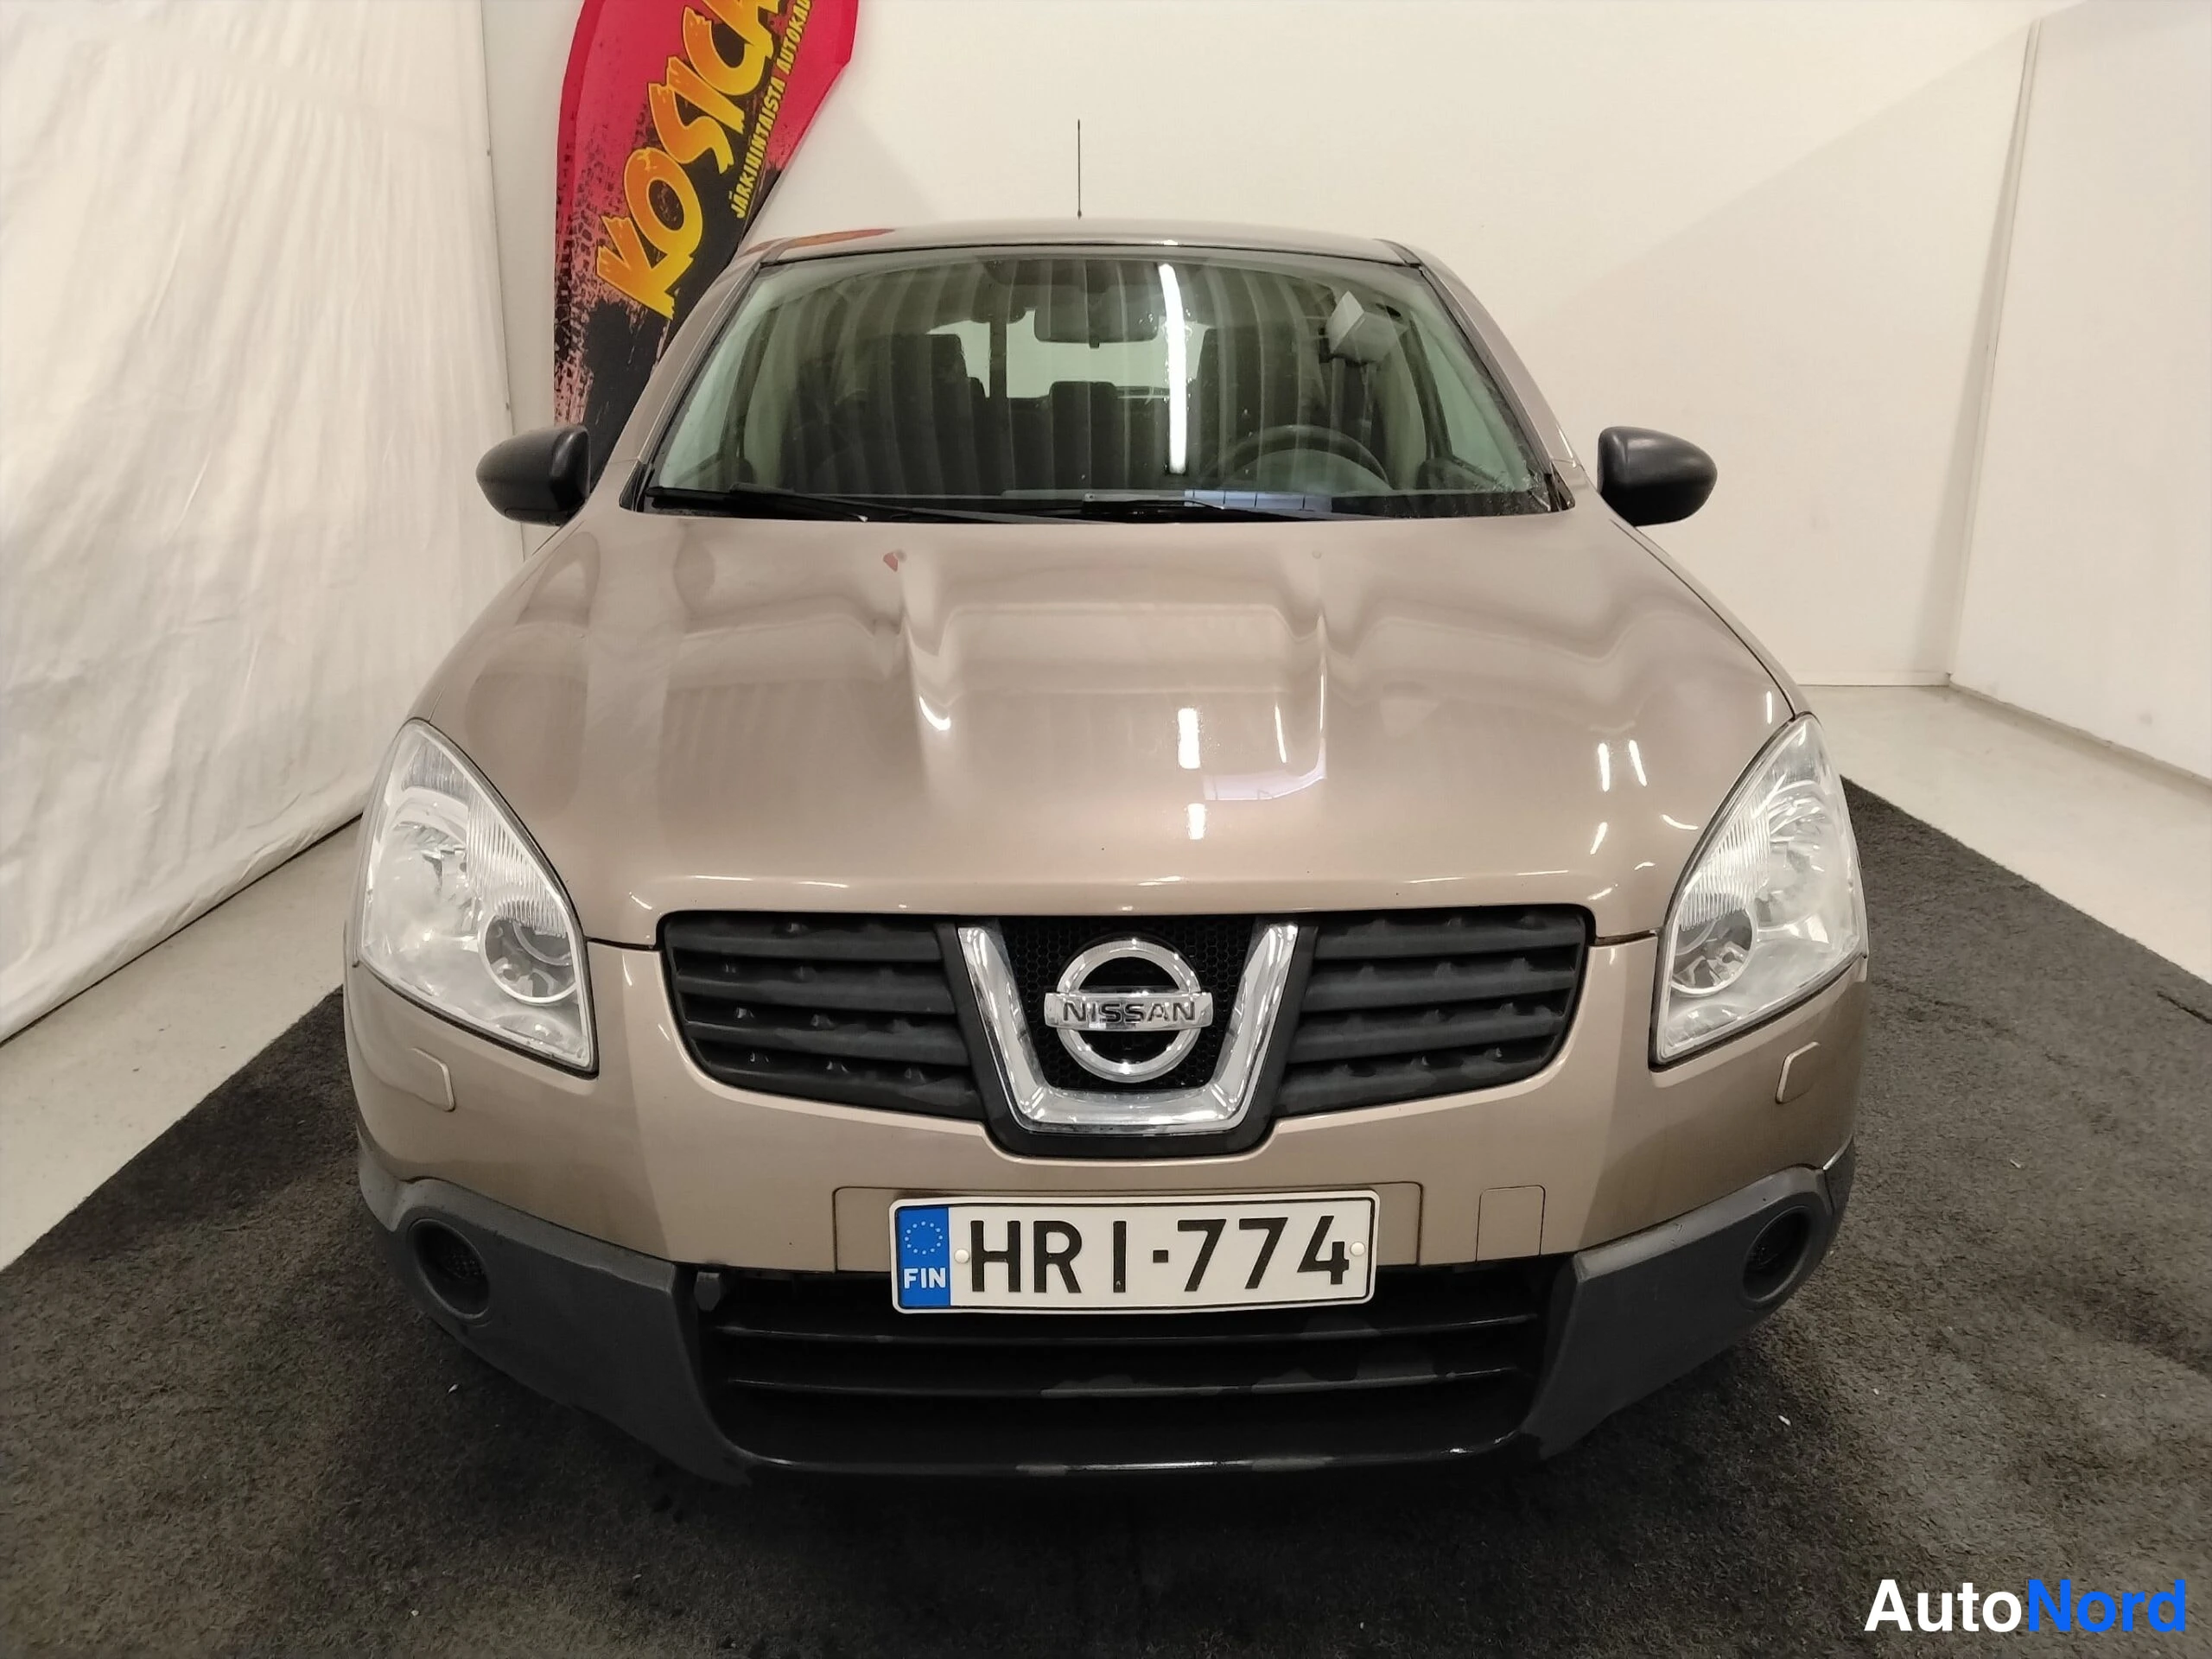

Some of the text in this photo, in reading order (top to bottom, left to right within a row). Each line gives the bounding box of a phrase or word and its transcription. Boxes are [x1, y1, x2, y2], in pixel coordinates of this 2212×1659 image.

[1063, 1001, 1196, 1022] NISSAN
[969, 1215, 1351, 1294] HRI-774
[903, 1267, 946, 1289] FIN
